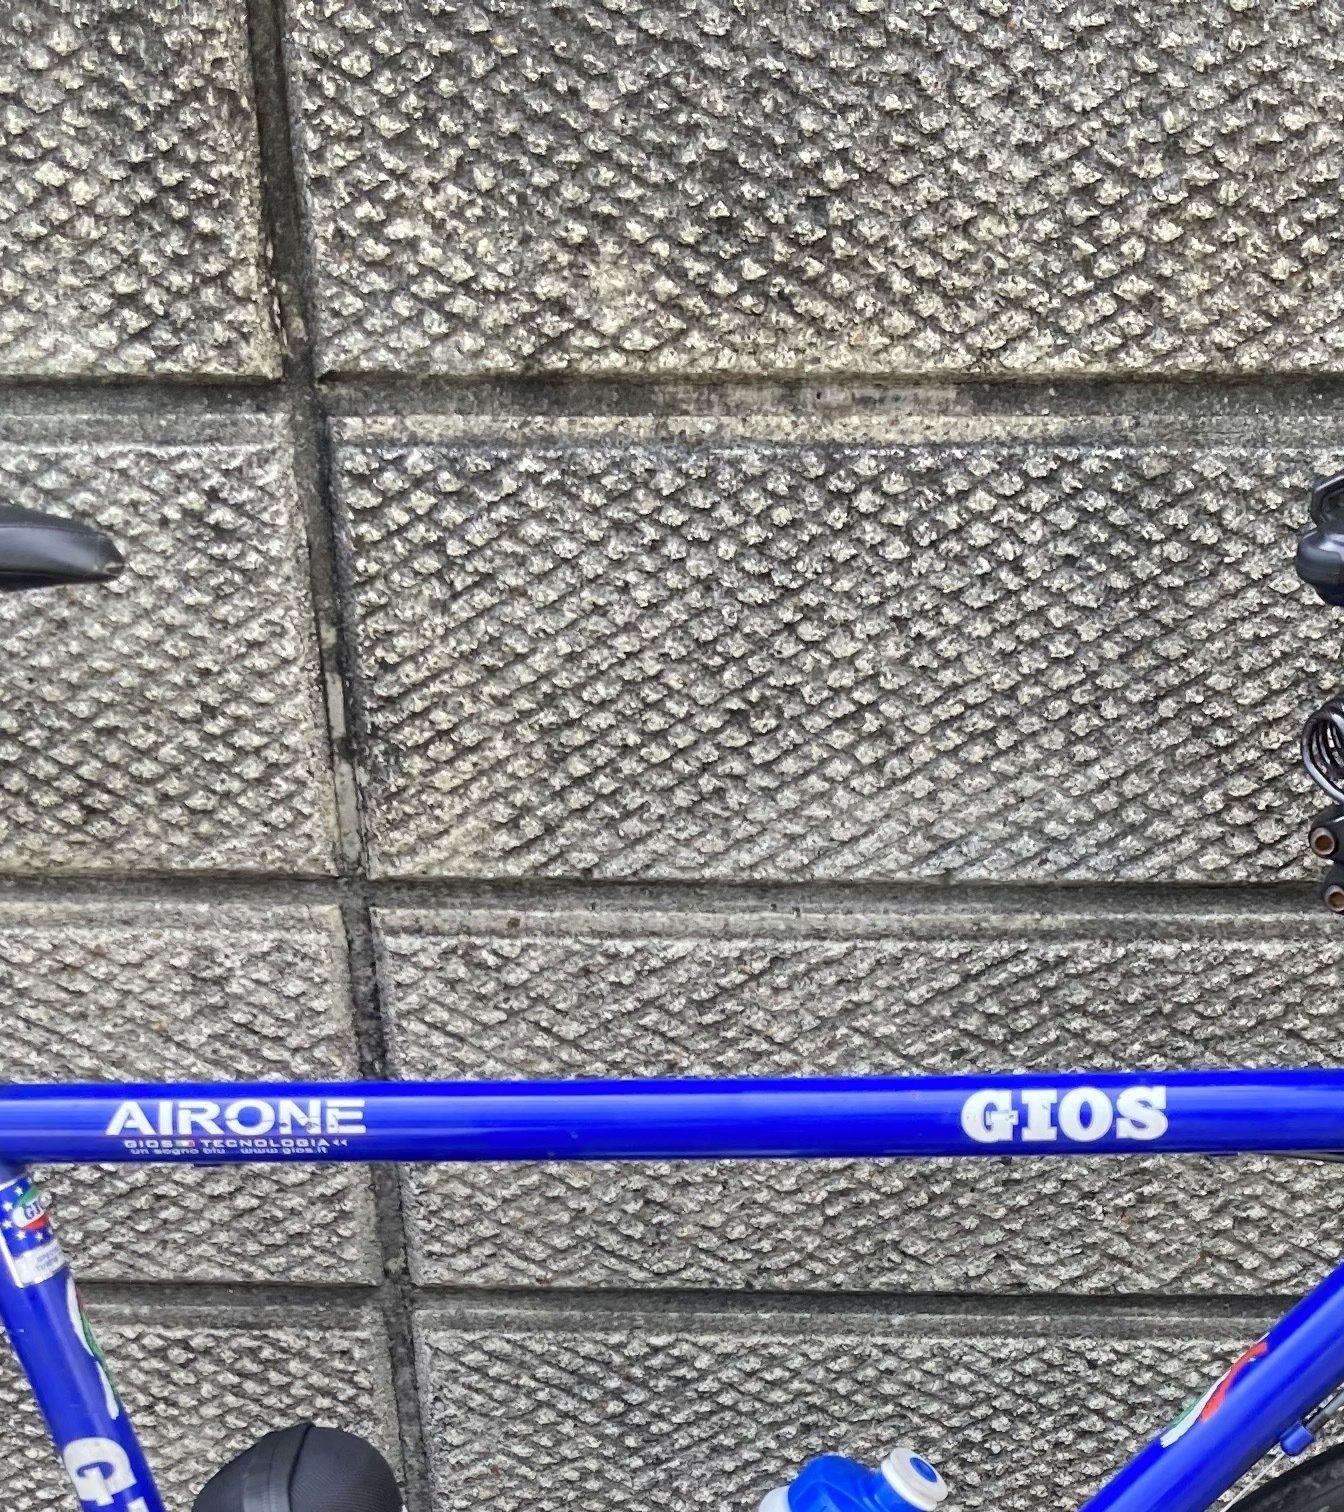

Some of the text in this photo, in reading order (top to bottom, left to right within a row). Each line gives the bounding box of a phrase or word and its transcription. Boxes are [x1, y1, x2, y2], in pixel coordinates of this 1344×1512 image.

[105, 1099, 366, 1136] AIRONE
[961, 1086, 1168, 1142] GIOS
[124, 1139, 174, 1148] GIOS
